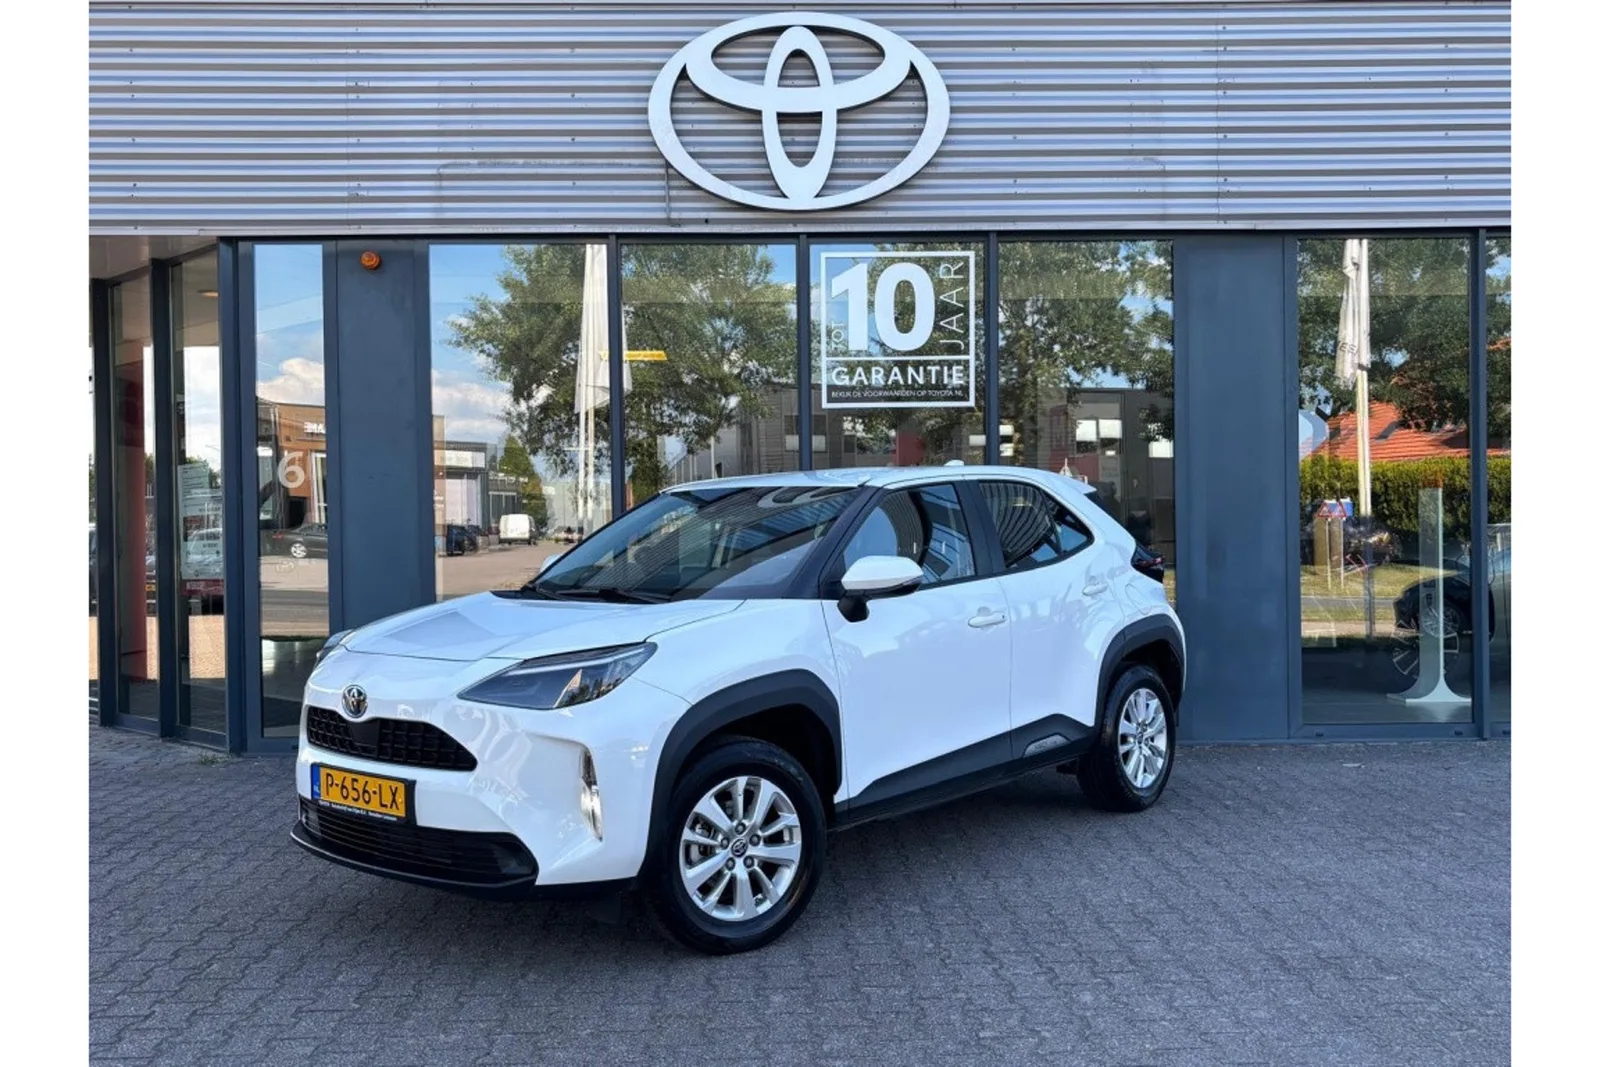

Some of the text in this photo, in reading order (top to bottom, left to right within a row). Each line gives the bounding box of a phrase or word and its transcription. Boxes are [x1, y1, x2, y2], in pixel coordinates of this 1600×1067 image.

[832, 262, 936, 351] 10
[939, 261, 965, 351] JAAR
[831, 321, 848, 351] TOT
[831, 366, 965, 386] GARANTIE
[916, 389, 927, 397] OP
[278, 451, 305, 489] 6
[325, 772, 400, 811] P-656-LX
